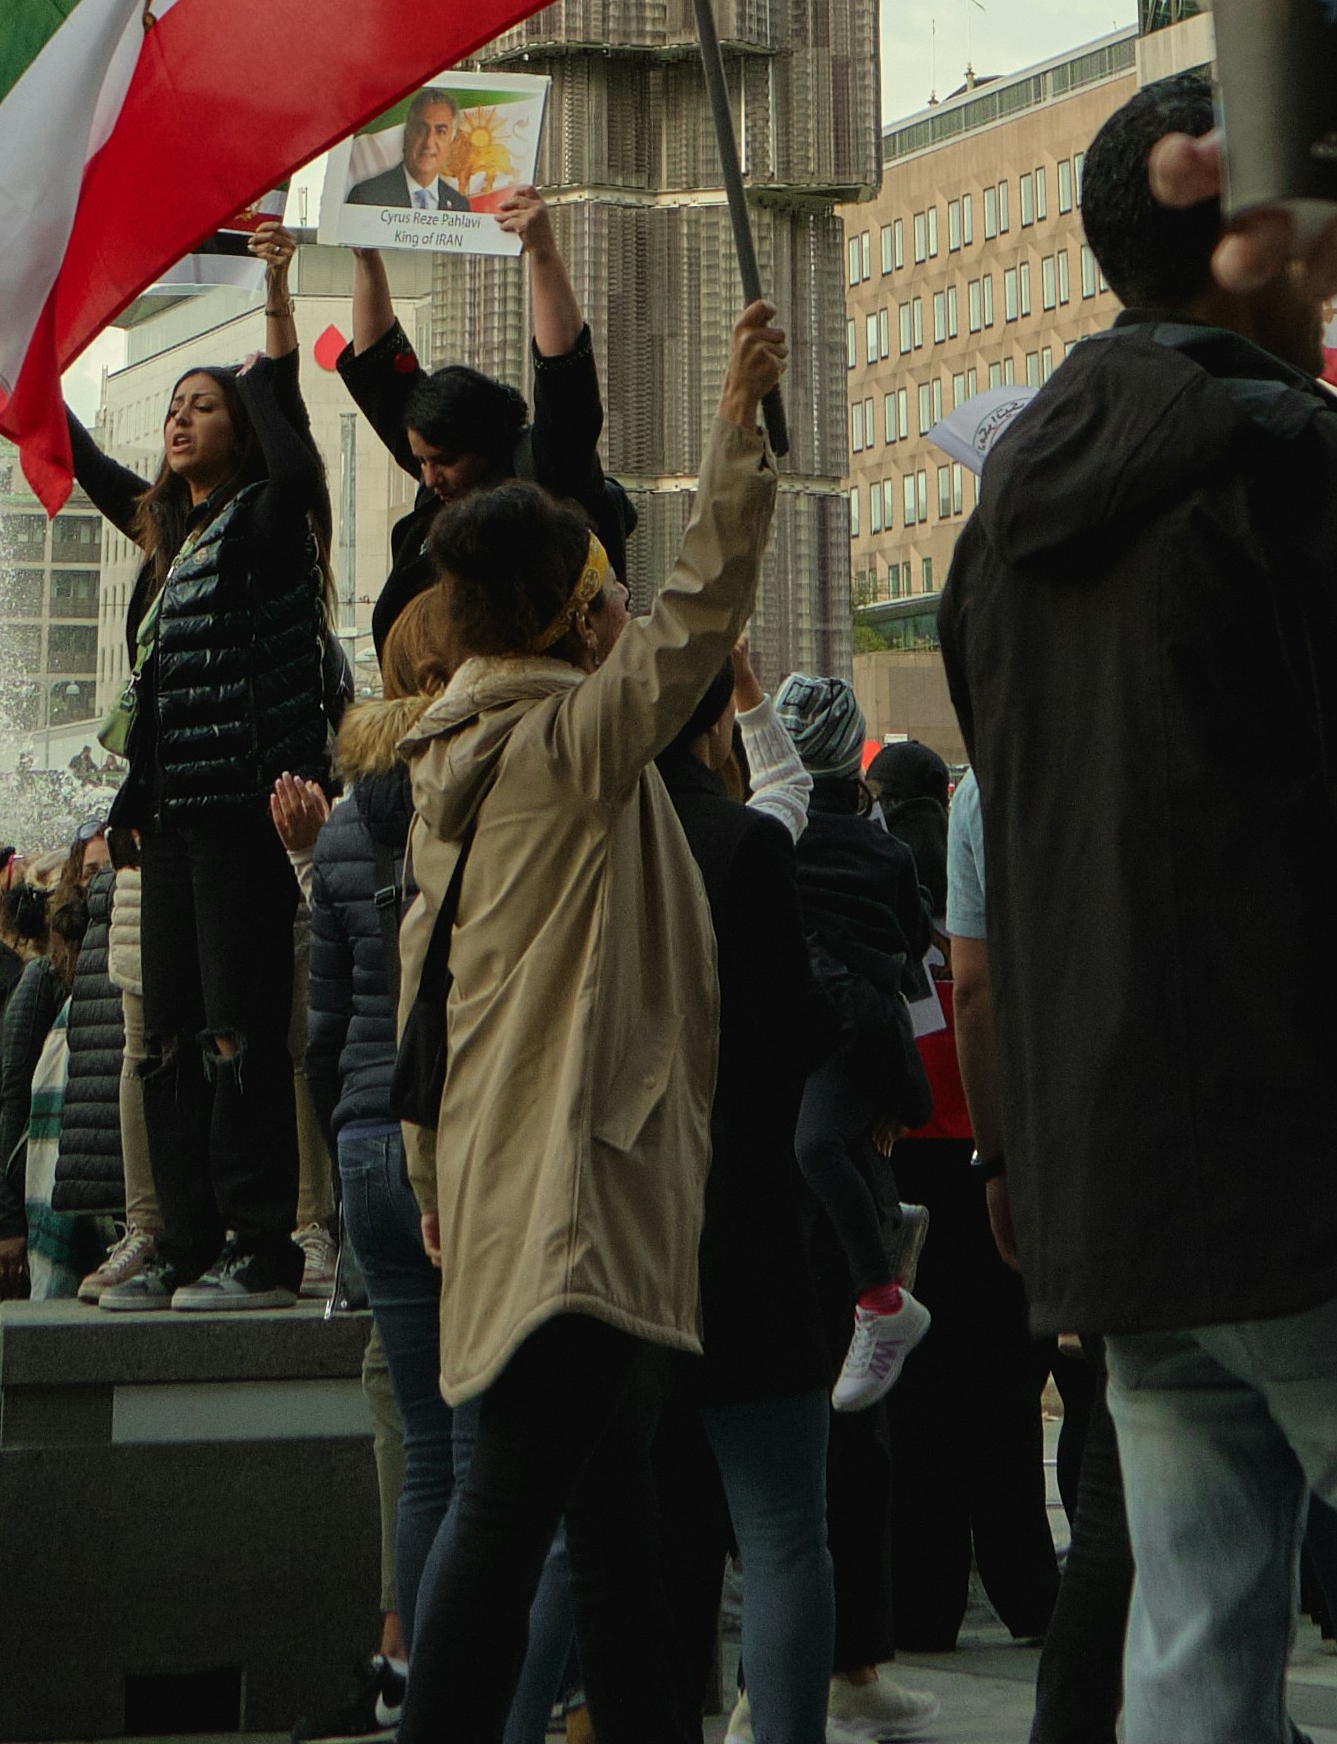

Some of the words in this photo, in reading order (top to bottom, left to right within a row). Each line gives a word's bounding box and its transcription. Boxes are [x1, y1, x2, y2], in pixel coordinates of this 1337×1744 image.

[380, 209, 411, 226] Cyrus
[441, 213, 481, 229] Pahlavi
[394, 229, 419, 247] King
[422, 231, 436, 246] of
[436, 233, 463, 247] IRAN
